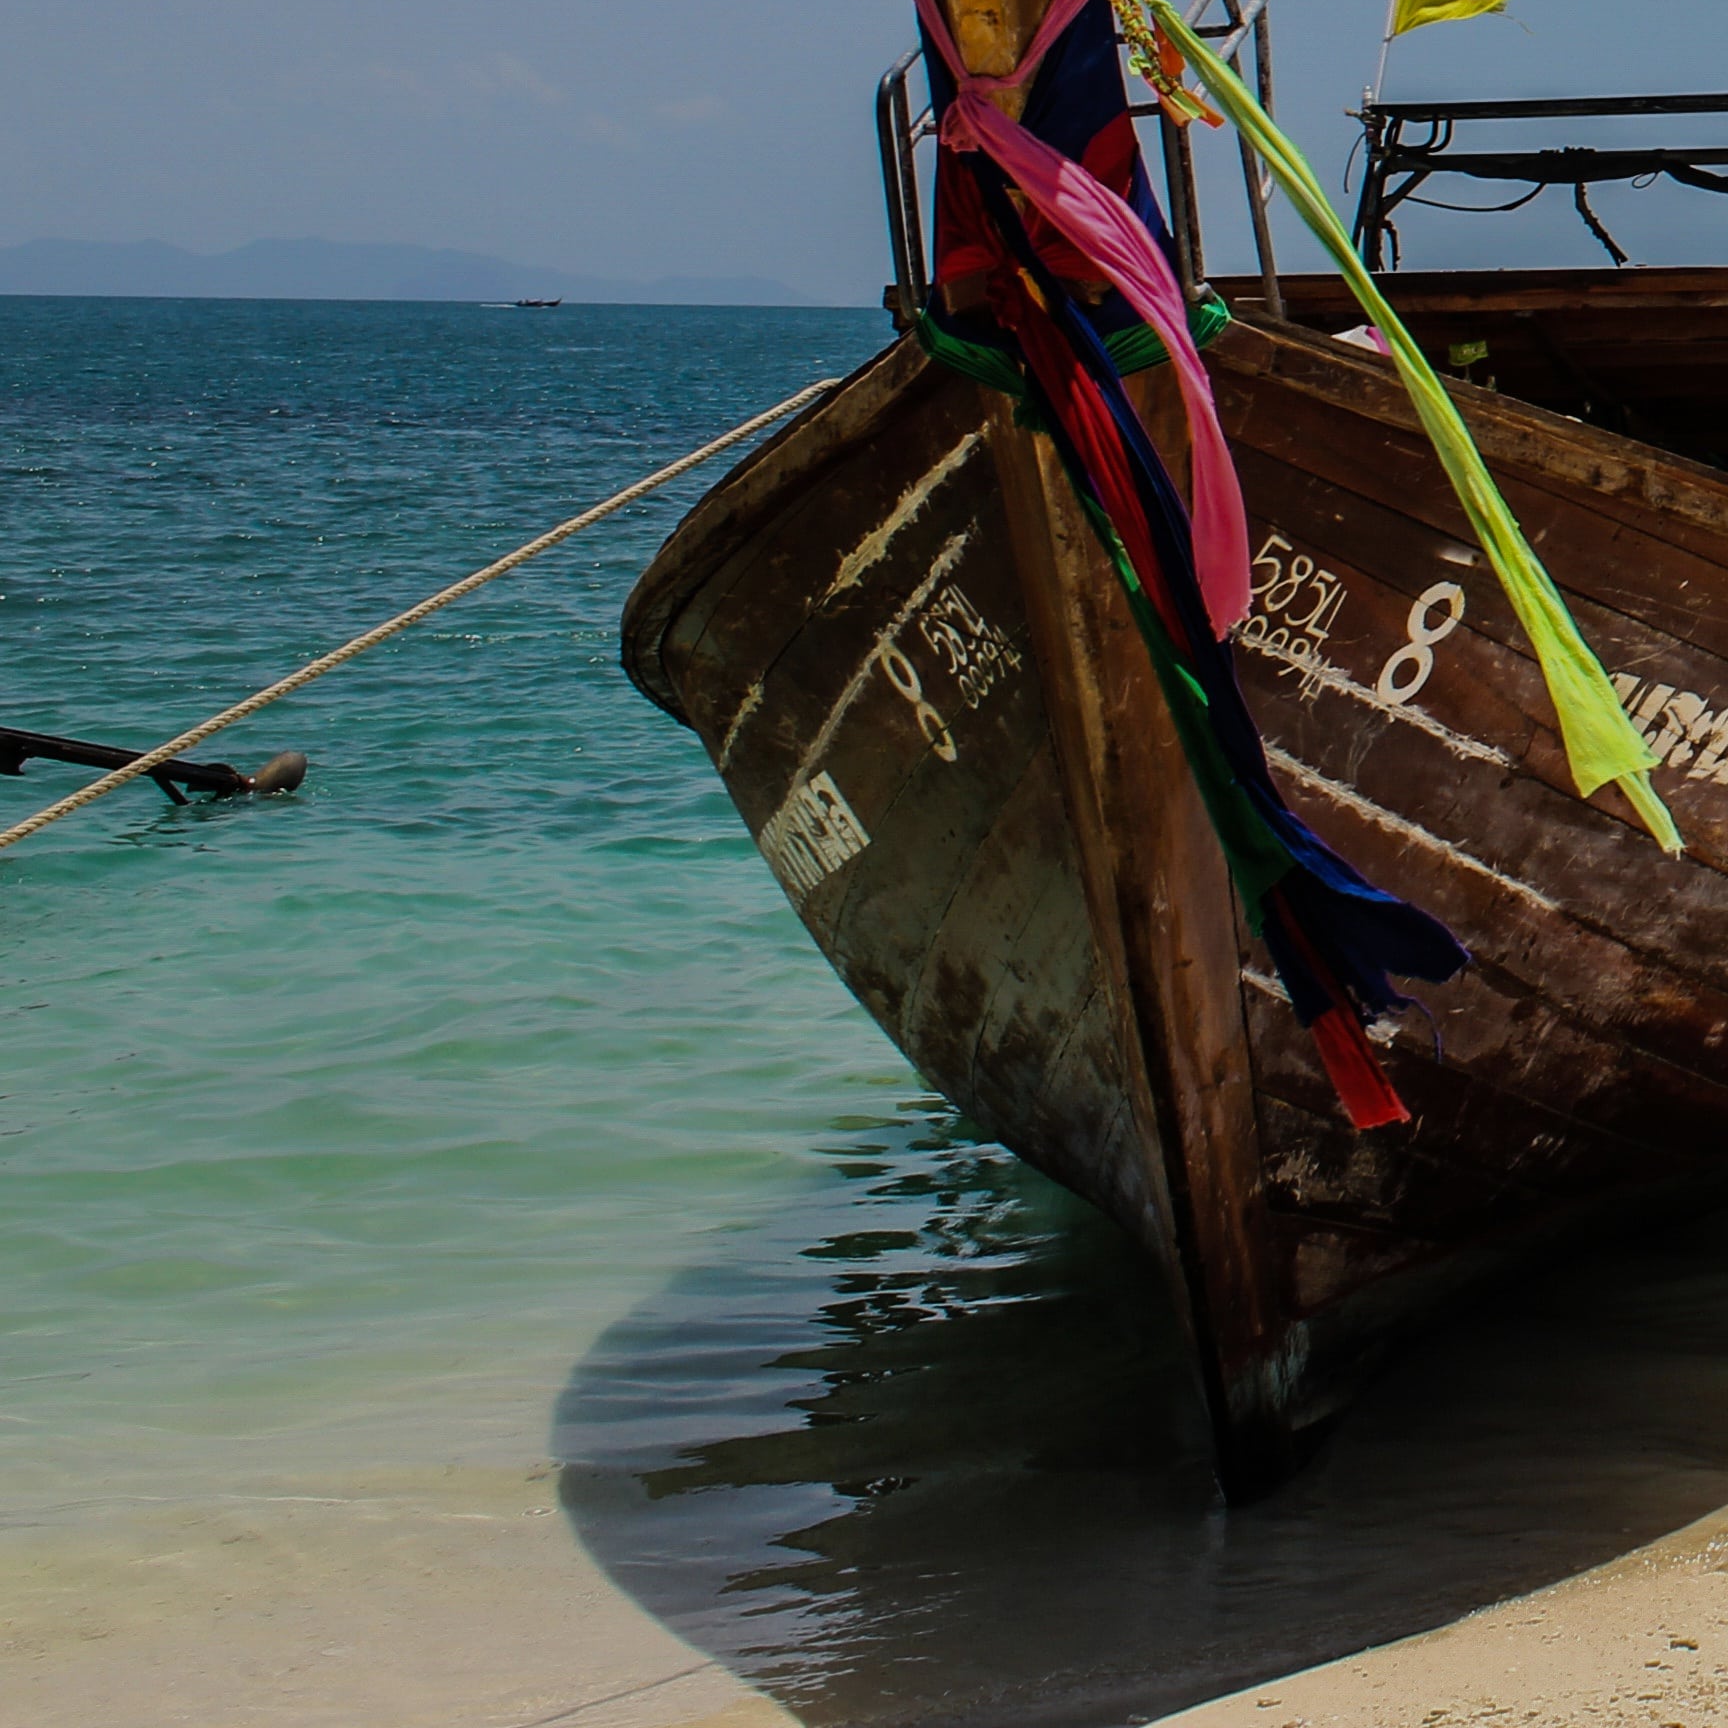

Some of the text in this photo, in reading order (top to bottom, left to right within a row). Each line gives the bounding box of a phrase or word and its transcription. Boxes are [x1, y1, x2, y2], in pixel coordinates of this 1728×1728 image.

[1251, 534, 1348, 652] 5854
[1377, 581, 1466, 705] 8
[881, 642, 958, 763] 8
[1231, 615, 1332, 702] 0094
